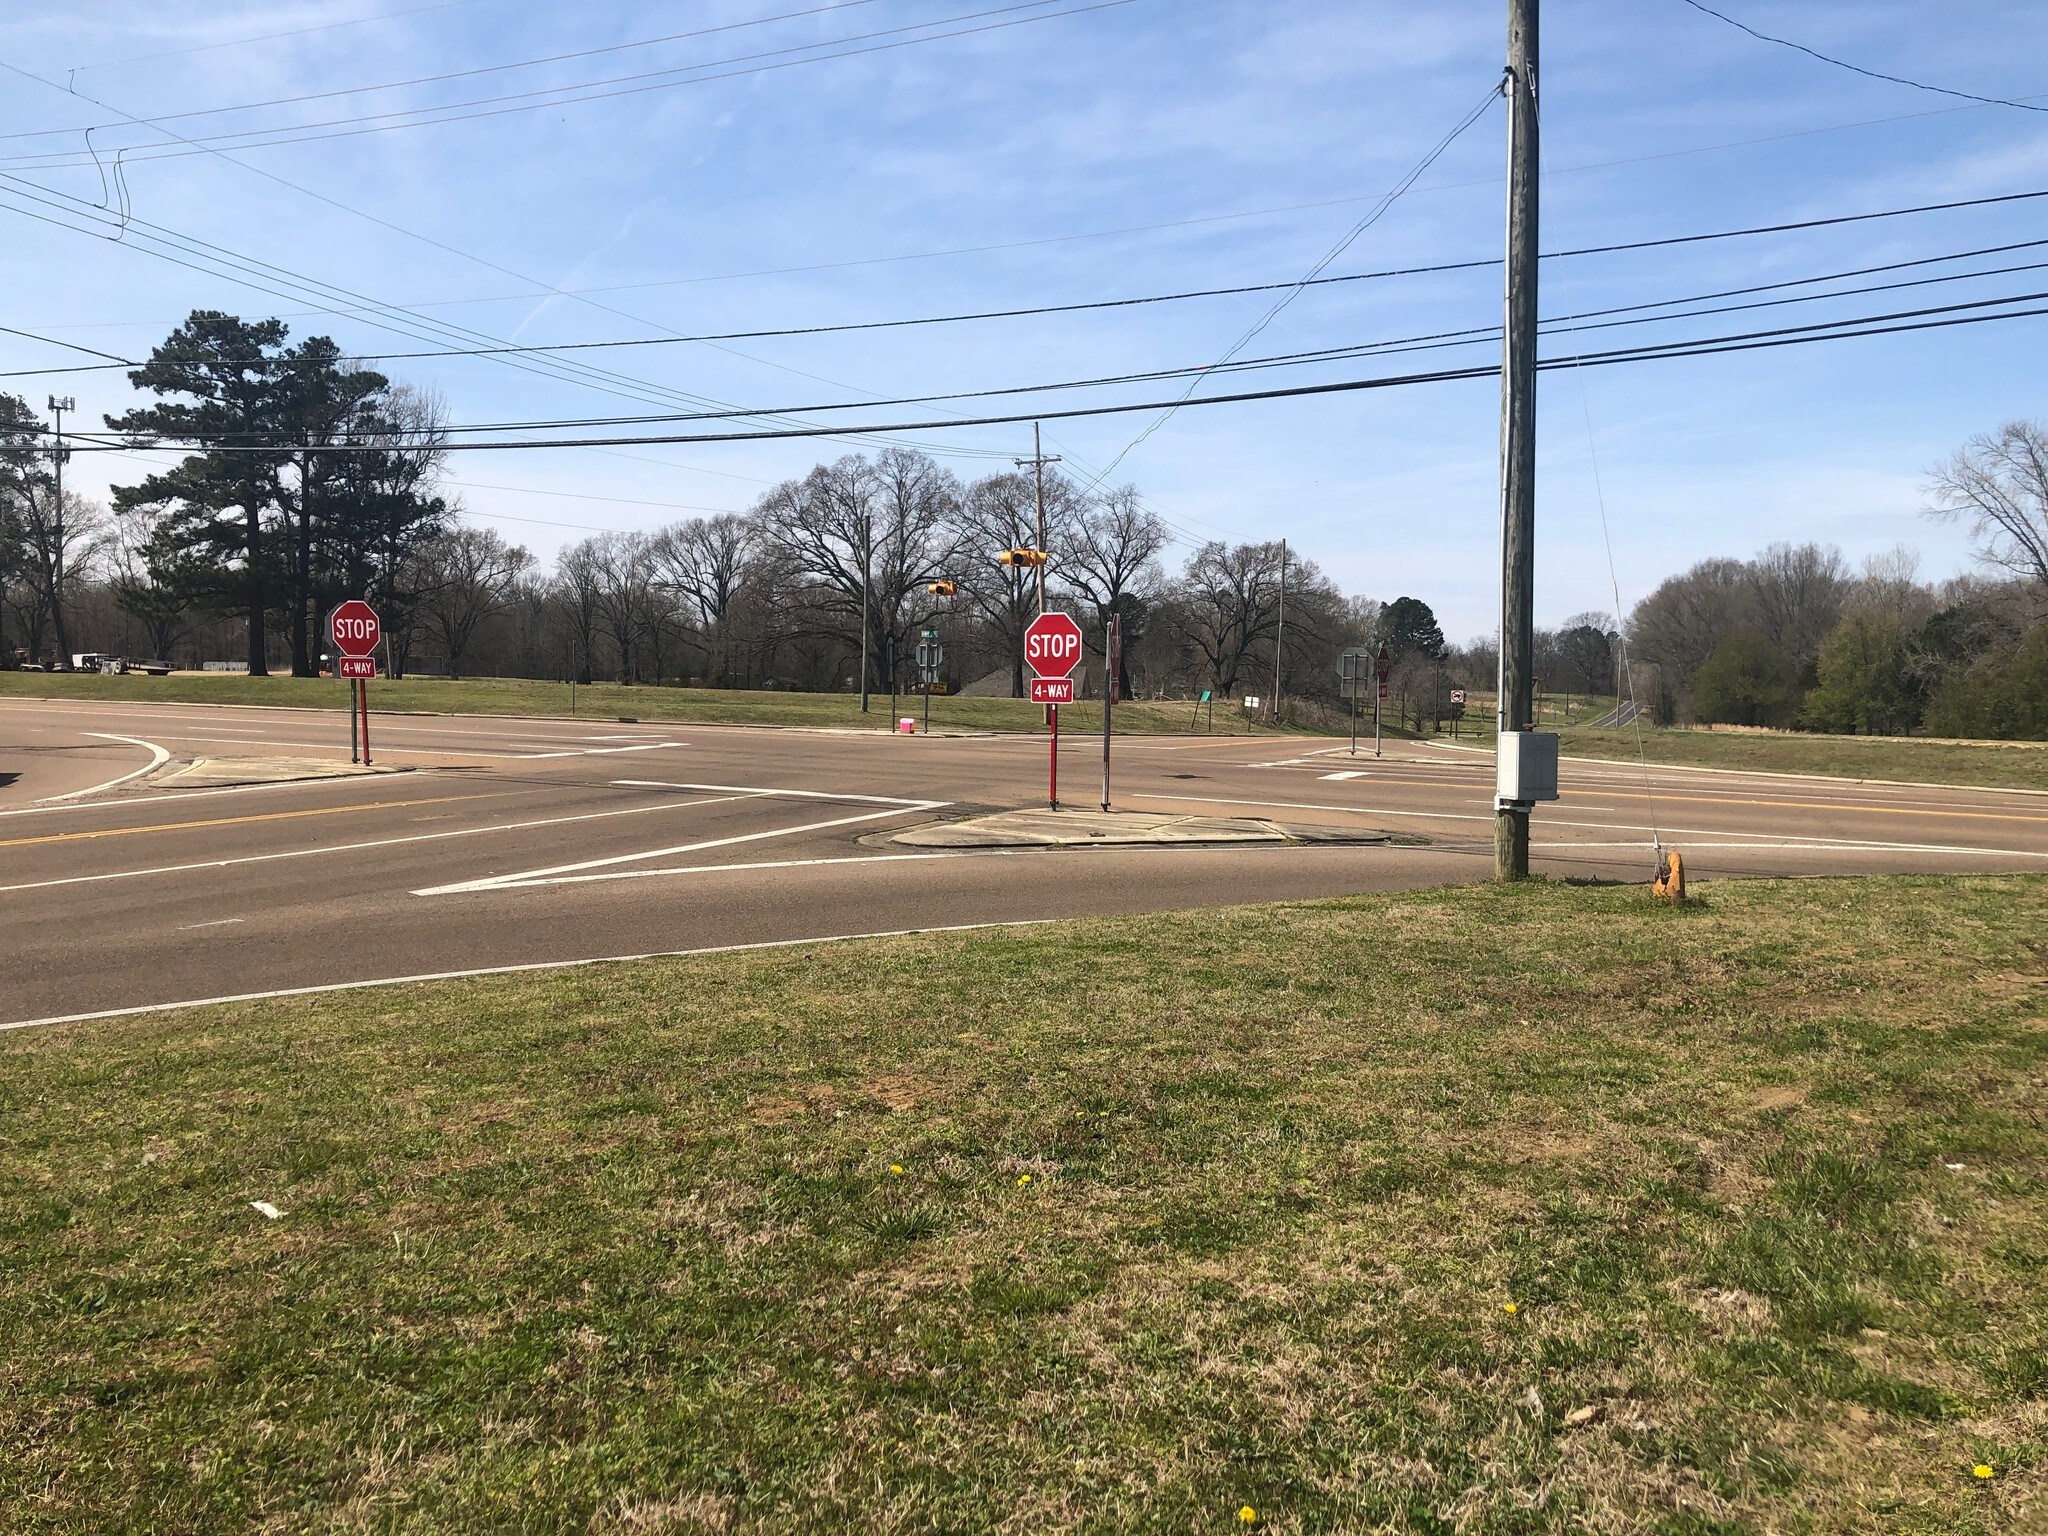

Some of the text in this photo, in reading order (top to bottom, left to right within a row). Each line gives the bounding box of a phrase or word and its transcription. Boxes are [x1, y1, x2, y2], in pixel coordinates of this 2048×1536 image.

[336, 618, 376, 639] STOP
[1029, 634, 1077, 657] STOP
[343, 662, 371, 674] 4-WAY
[1034, 684, 1069, 698] 4-WAY
